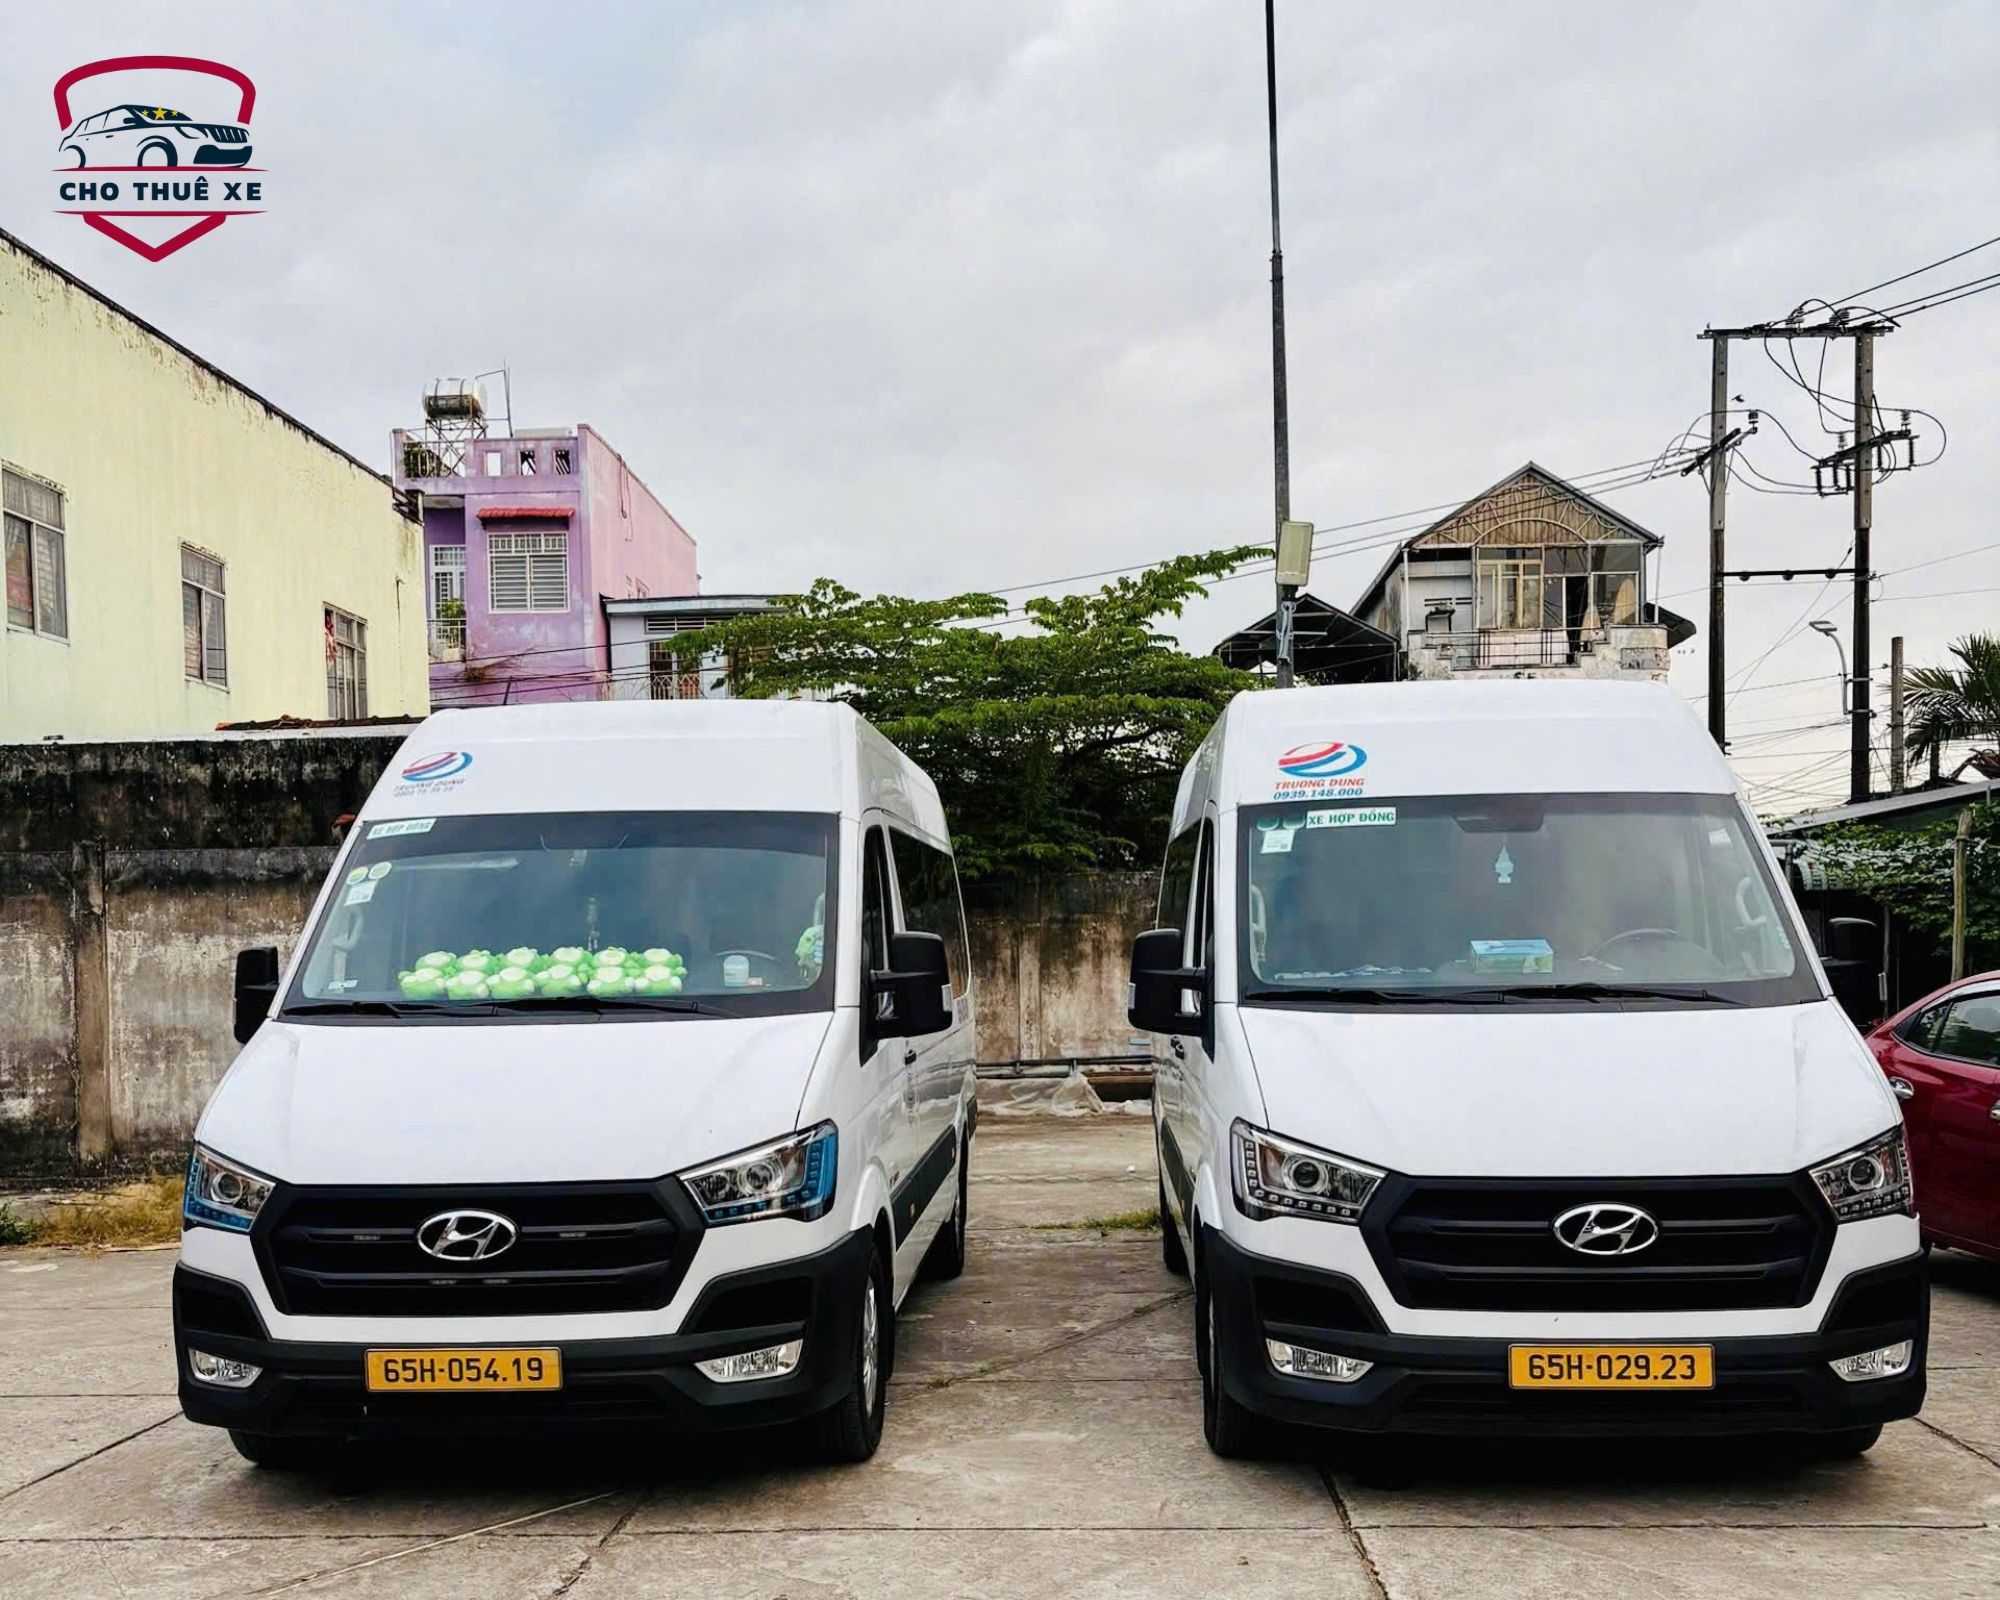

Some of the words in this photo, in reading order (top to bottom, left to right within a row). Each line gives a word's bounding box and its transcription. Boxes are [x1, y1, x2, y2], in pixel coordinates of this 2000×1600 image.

[1273, 787, 1363, 800] 0939.148.000
[1308, 815, 1324, 825] XE
[383, 1357, 544, 1383] 65H-054.19
[1528, 1353, 1696, 1380] 65H-029.23
